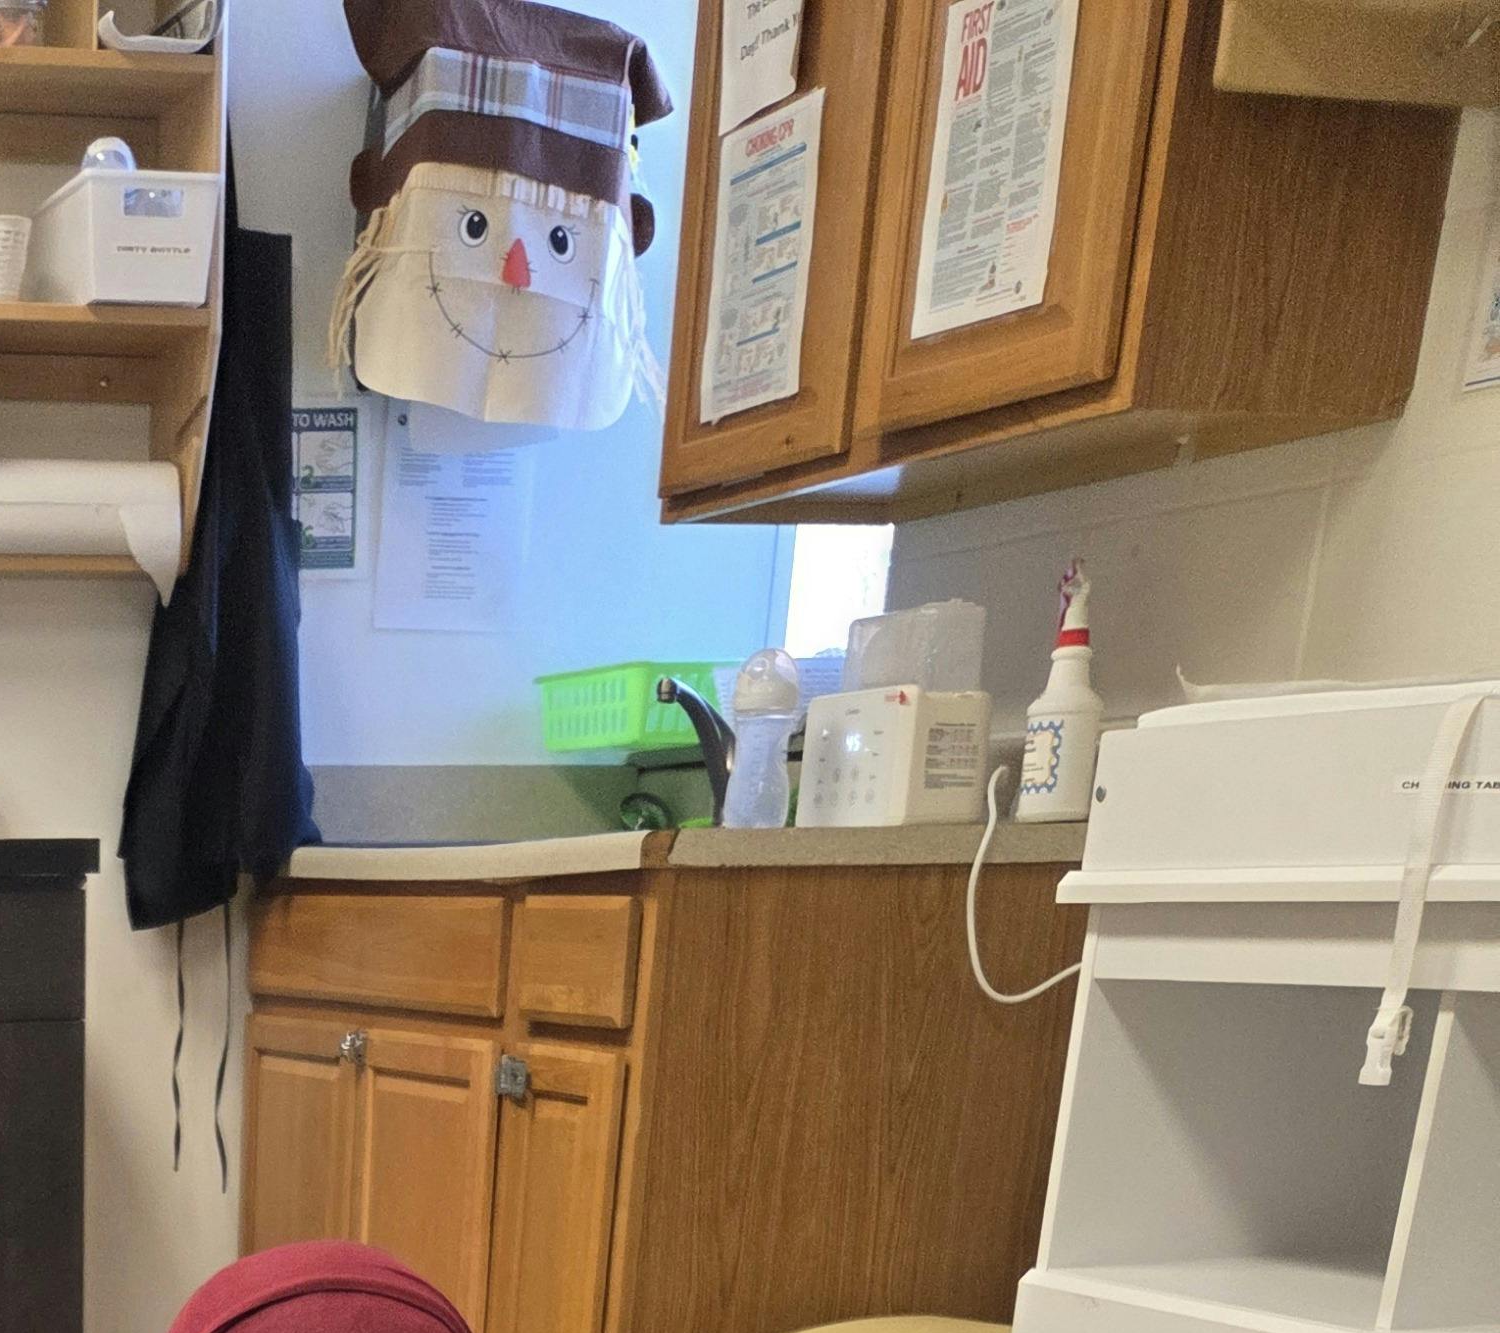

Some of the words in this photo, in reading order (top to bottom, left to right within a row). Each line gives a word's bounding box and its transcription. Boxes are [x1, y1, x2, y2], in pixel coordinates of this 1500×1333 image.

[961, 0, 995, 43] FIRST
[954, 37, 987, 101] AID
[116, 245, 148, 253] DIRTY
[293, 413, 310, 427] TO
[313, 413, 354, 428] WASH
[1402, 780, 1471, 790] CHING
